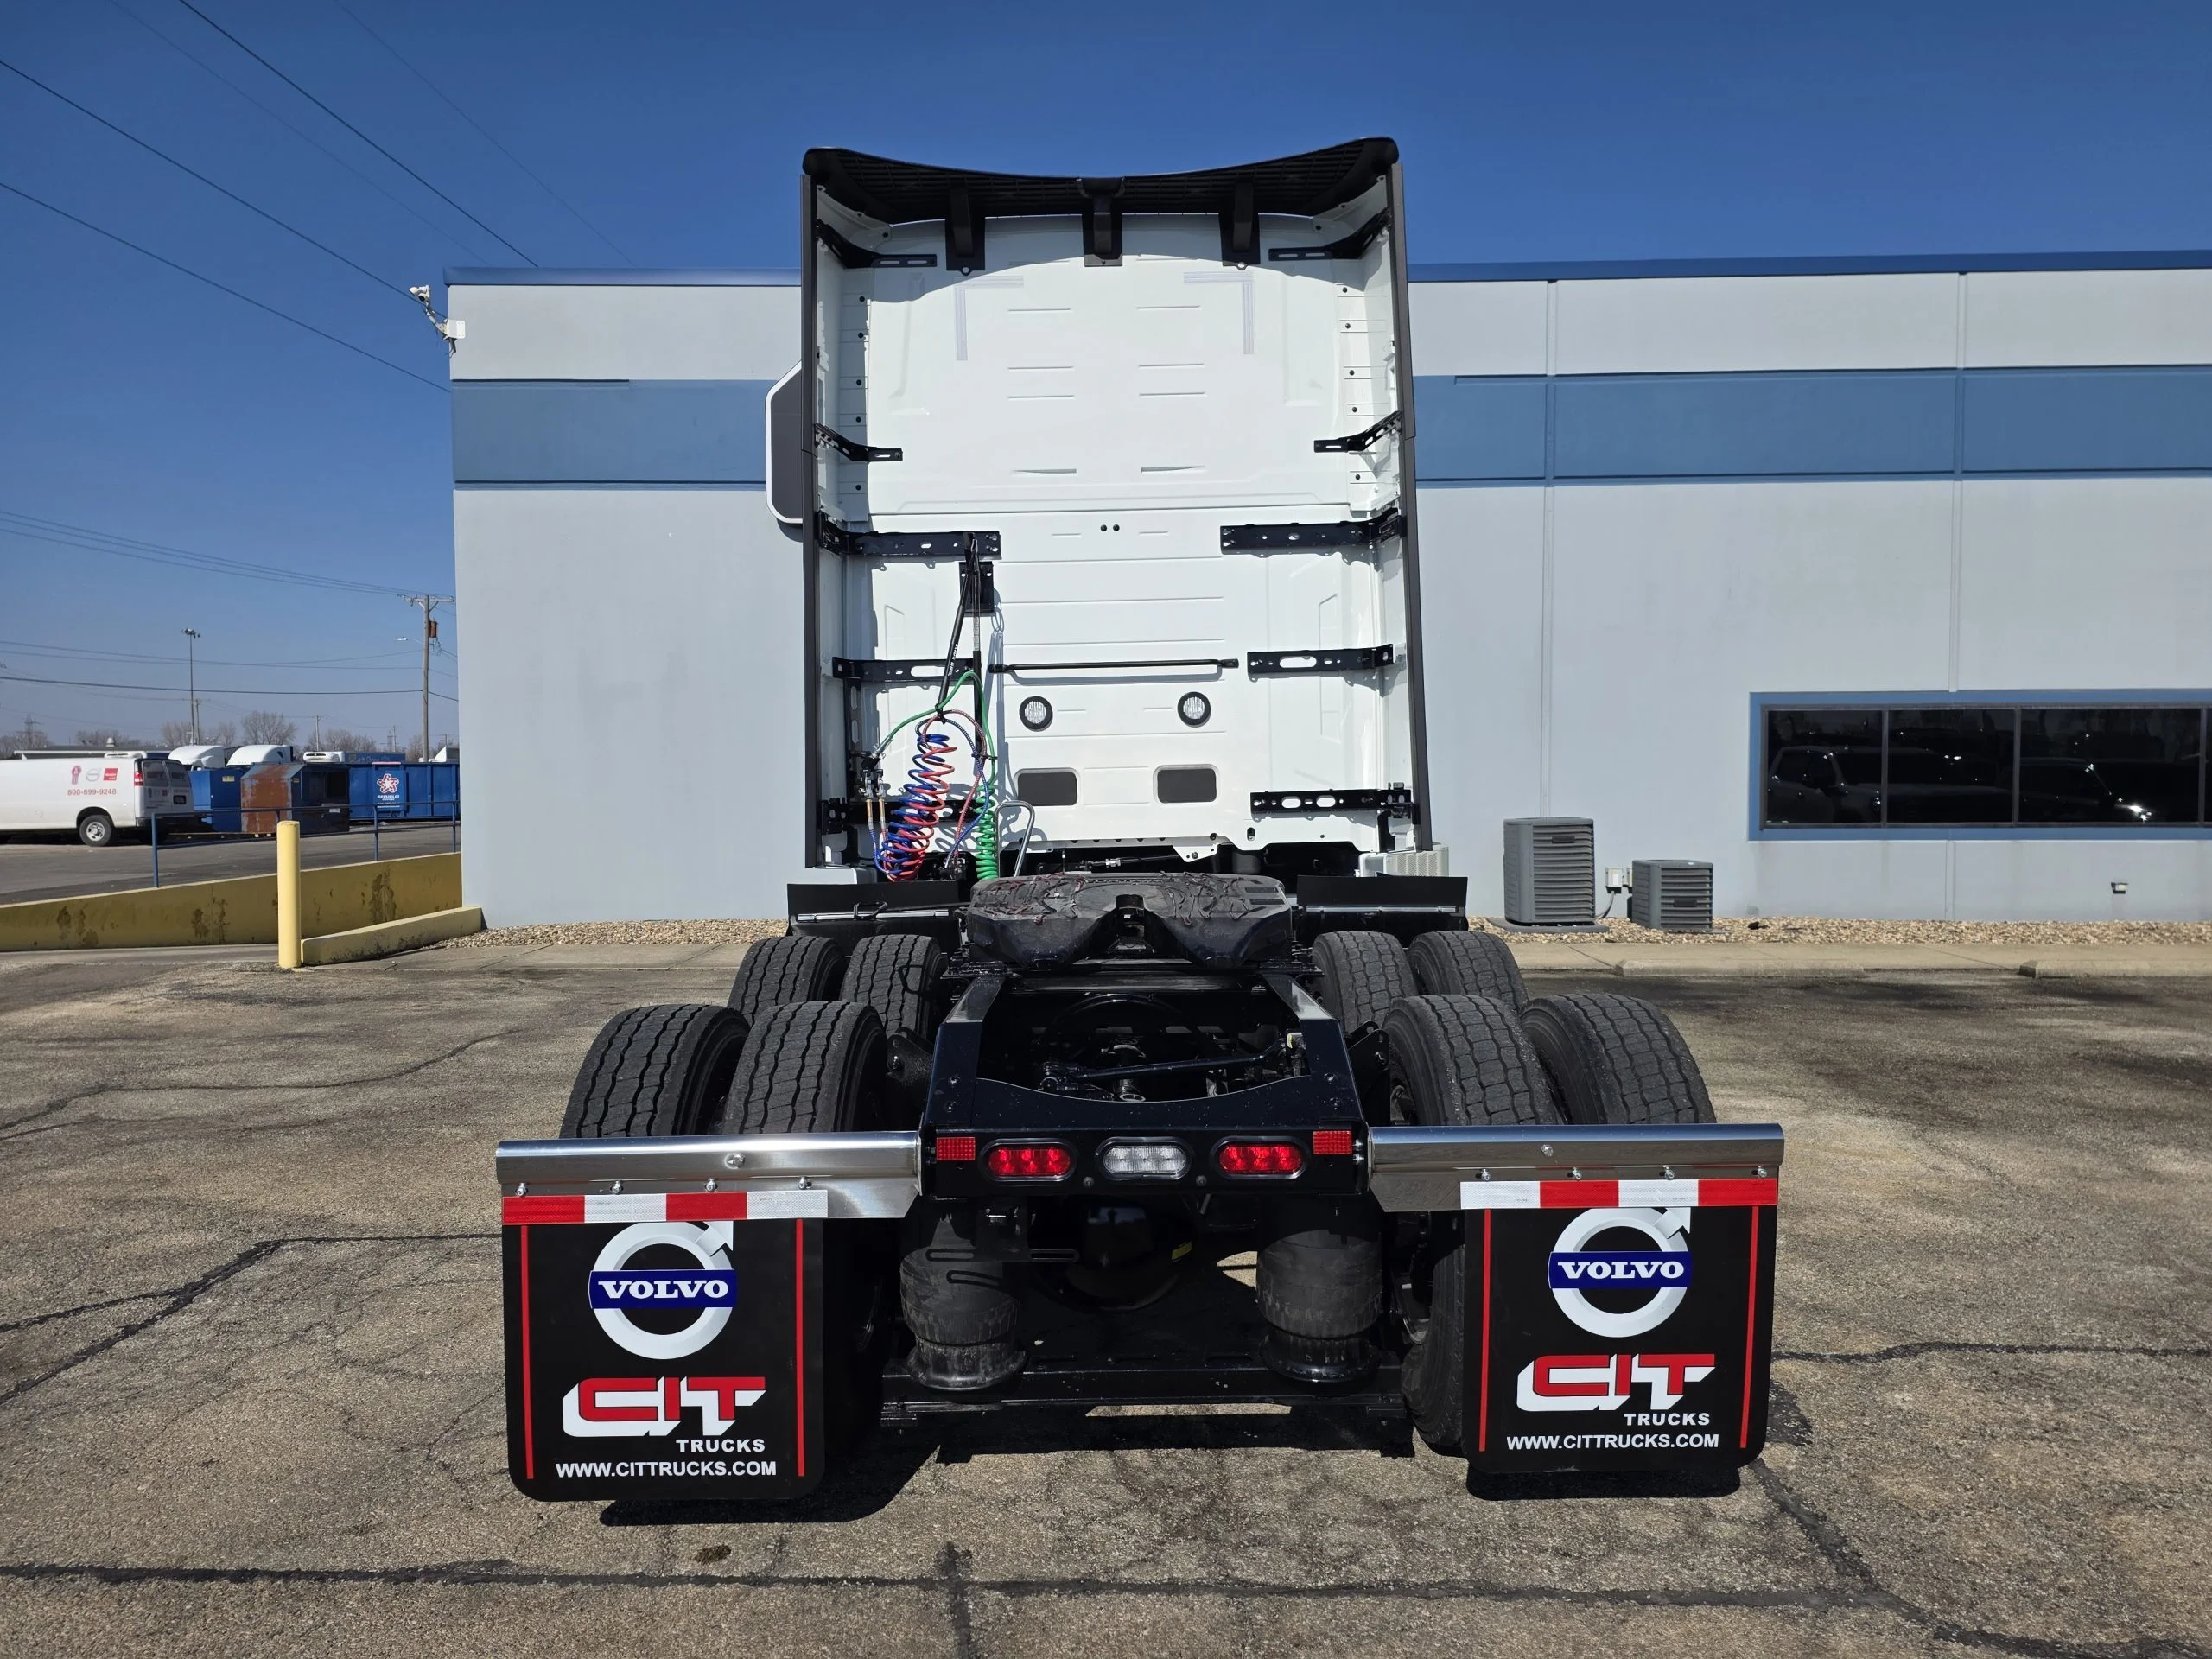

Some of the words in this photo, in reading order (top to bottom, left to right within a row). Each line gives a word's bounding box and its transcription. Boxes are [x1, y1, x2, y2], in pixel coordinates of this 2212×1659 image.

[1558, 1261, 1684, 1279] VOLVO
[598, 1280, 728, 1299] VOLVO
[1516, 1354, 1715, 1411] CIT
[563, 1376, 766, 1437] CIT
[1624, 1413, 1710, 1426] TRUCKS
[676, 1439, 766, 1452] TRUCKS
[1507, 1433, 1719, 1450] WWW.CITTRUCKS.COM
[556, 1461, 777, 1478] WWW.CITTRUCKS.COM
